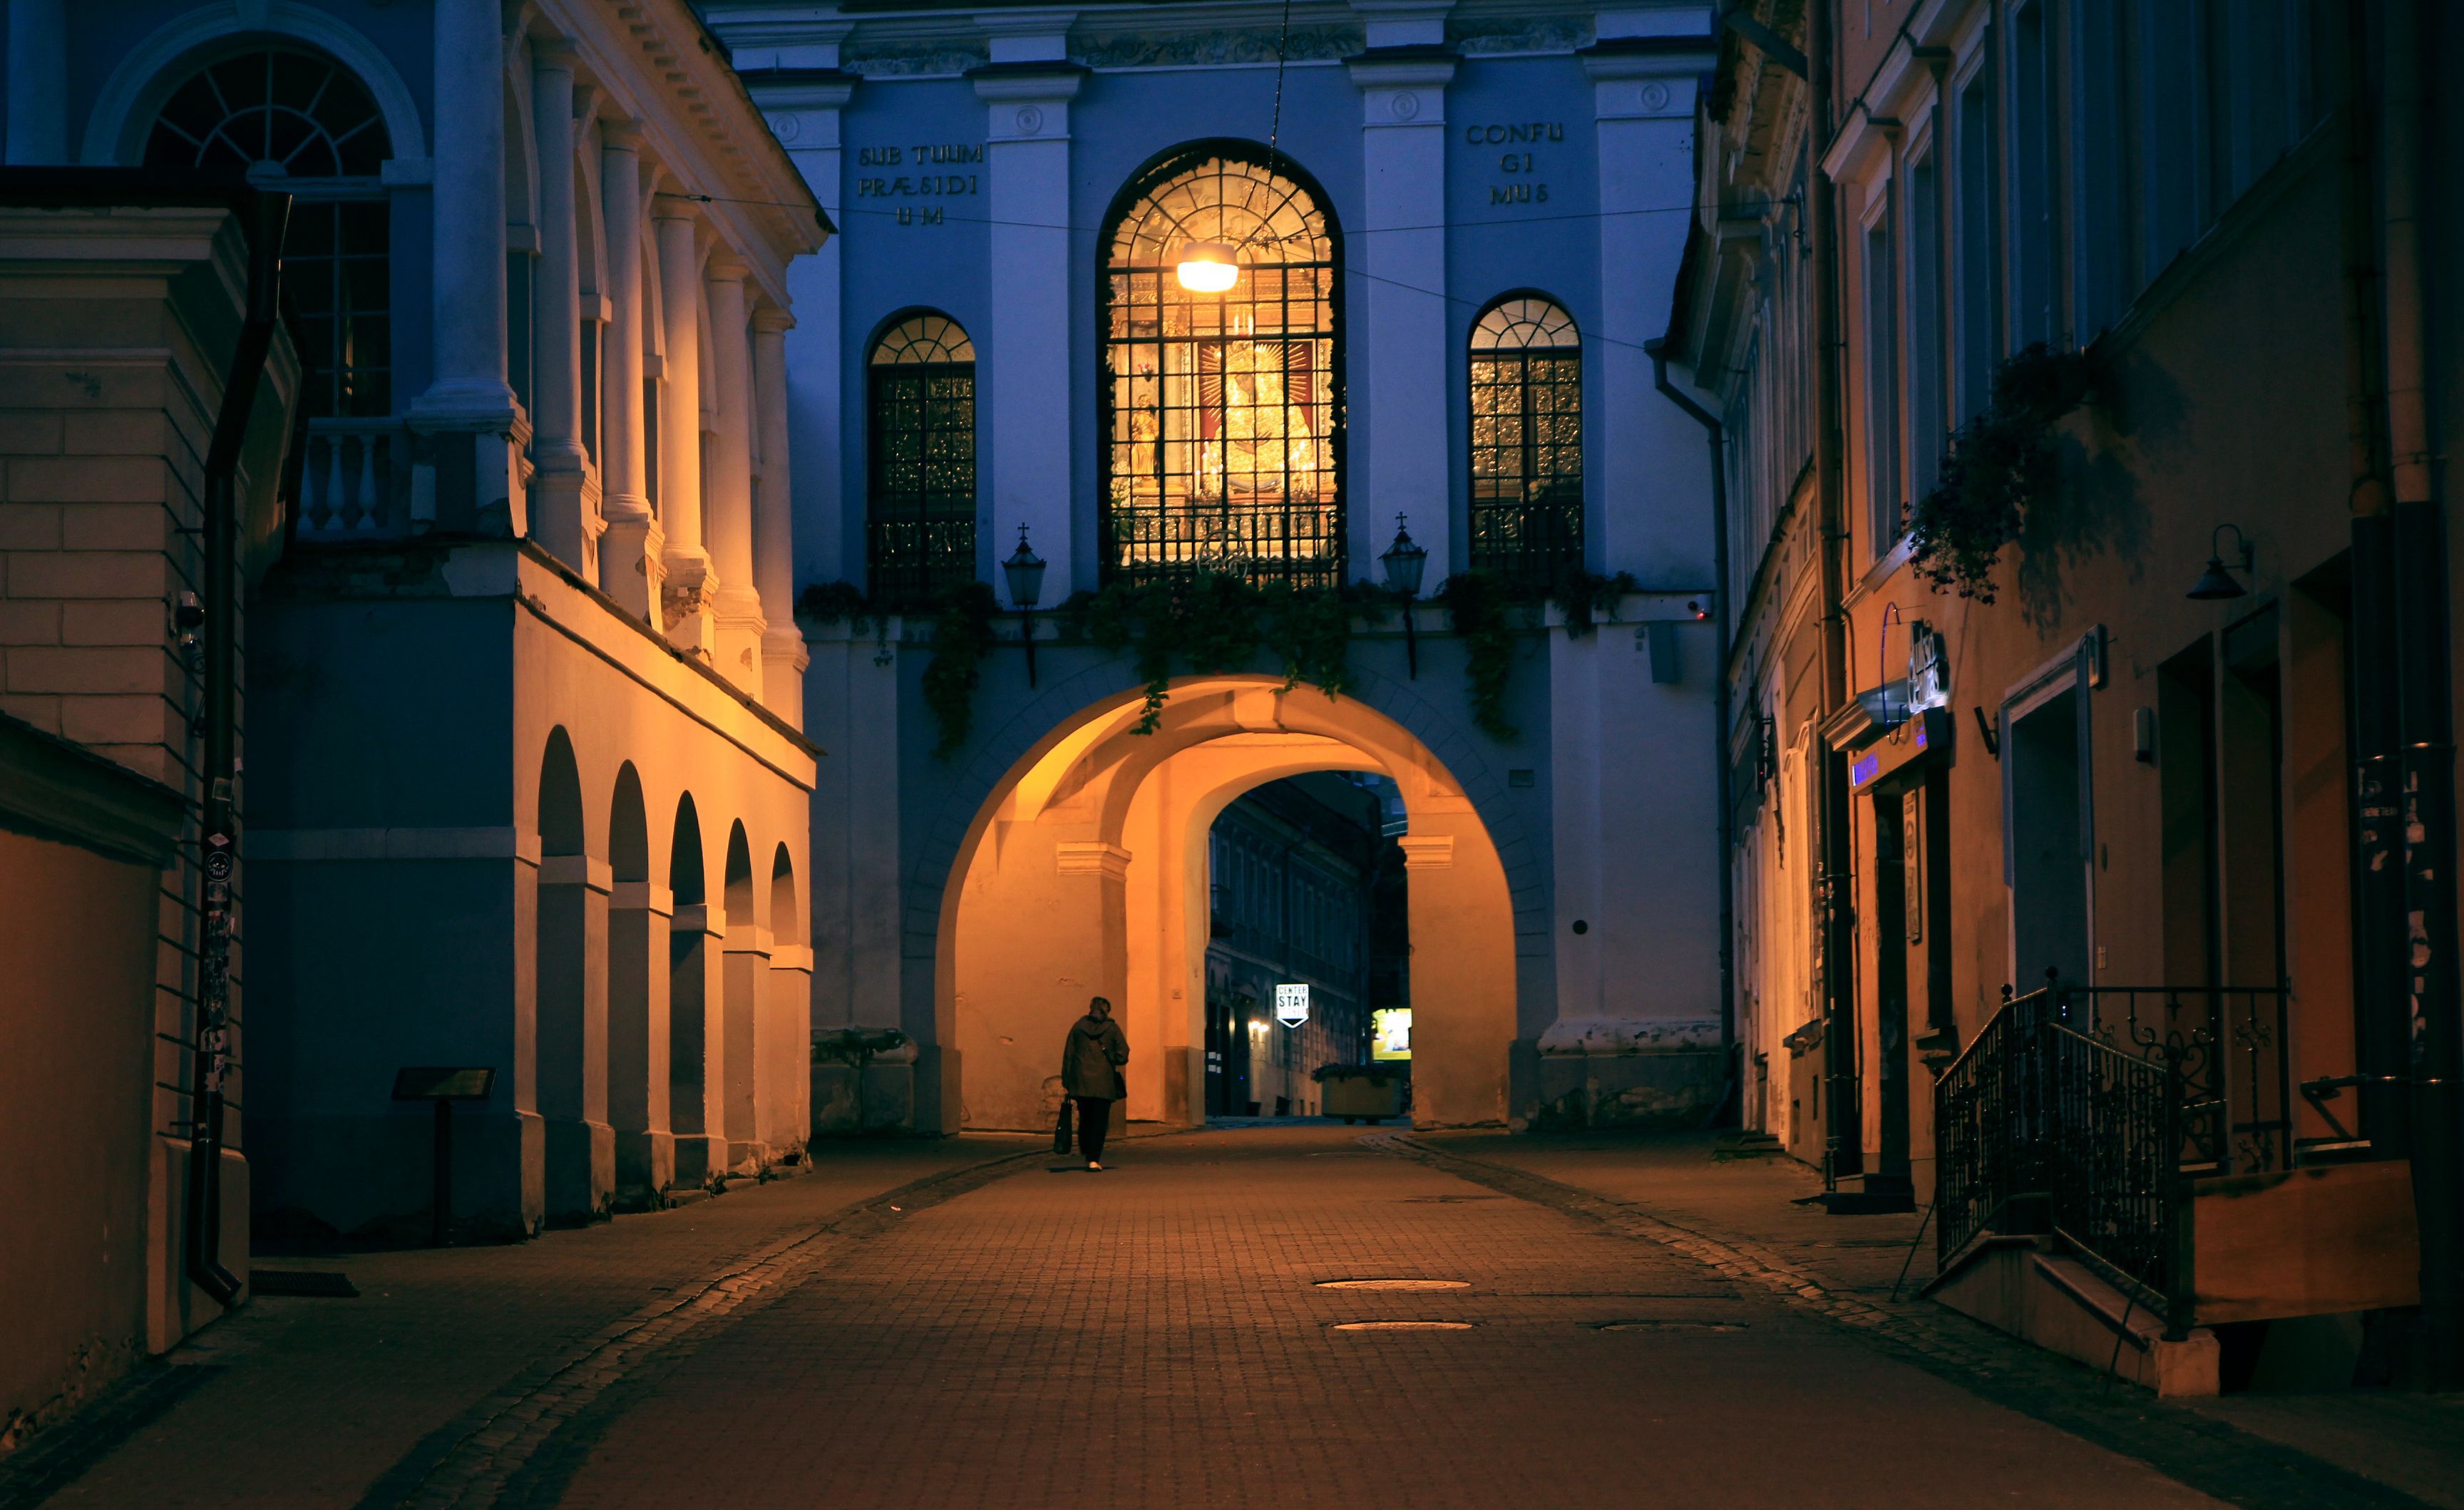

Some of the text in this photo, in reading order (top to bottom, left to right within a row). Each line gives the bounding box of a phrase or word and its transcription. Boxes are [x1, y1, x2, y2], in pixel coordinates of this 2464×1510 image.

[1465, 122, 1564, 144] CONFU
[858, 143, 983, 166] SUB TUUM
[1499, 152, 1533, 173] GI
[858, 175, 977, 197] PRÆSIDI
[1489, 183, 1549, 205] MUS
[1278, 986, 1308, 995] CENTER
[1278, 995, 1306, 1007] STAY
